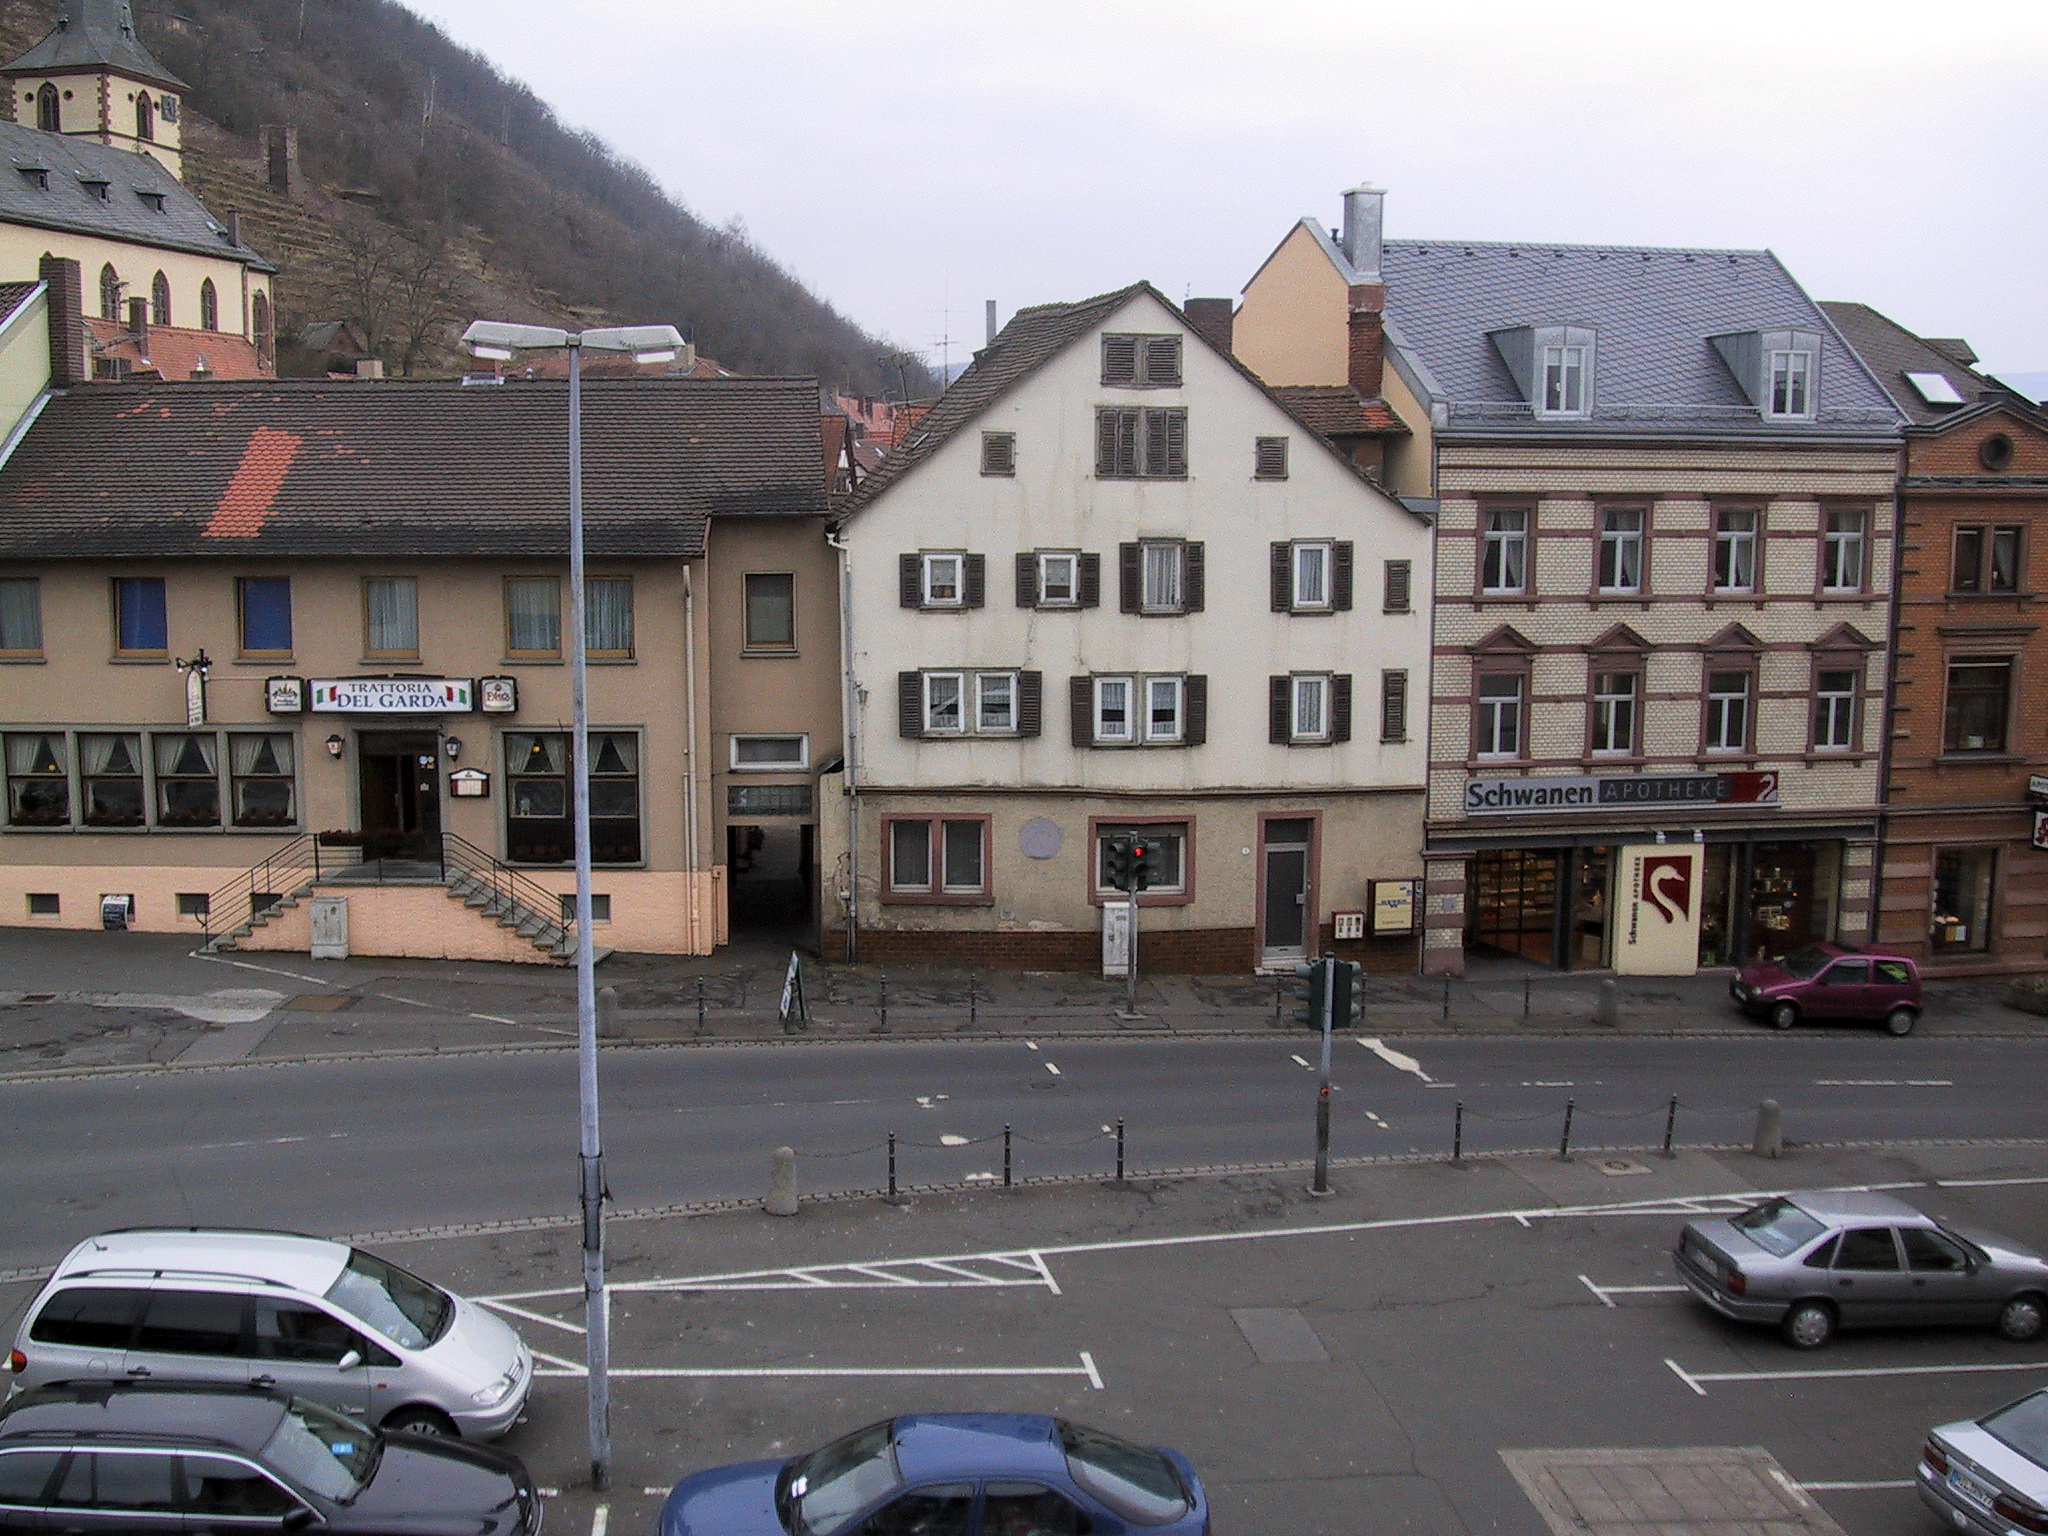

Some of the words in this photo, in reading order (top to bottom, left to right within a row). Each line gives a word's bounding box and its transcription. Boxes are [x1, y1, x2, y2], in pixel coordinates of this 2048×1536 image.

[349, 683, 432, 693] TRATTORIA
[337, 694, 374, 708] DEL
[379, 693, 448, 708] GARDA
[1468, 782, 1593, 807] Schwanen
[1605, 780, 1727, 799] APOTHEKE
[1632, 857, 1641, 899] APOTHEKE
